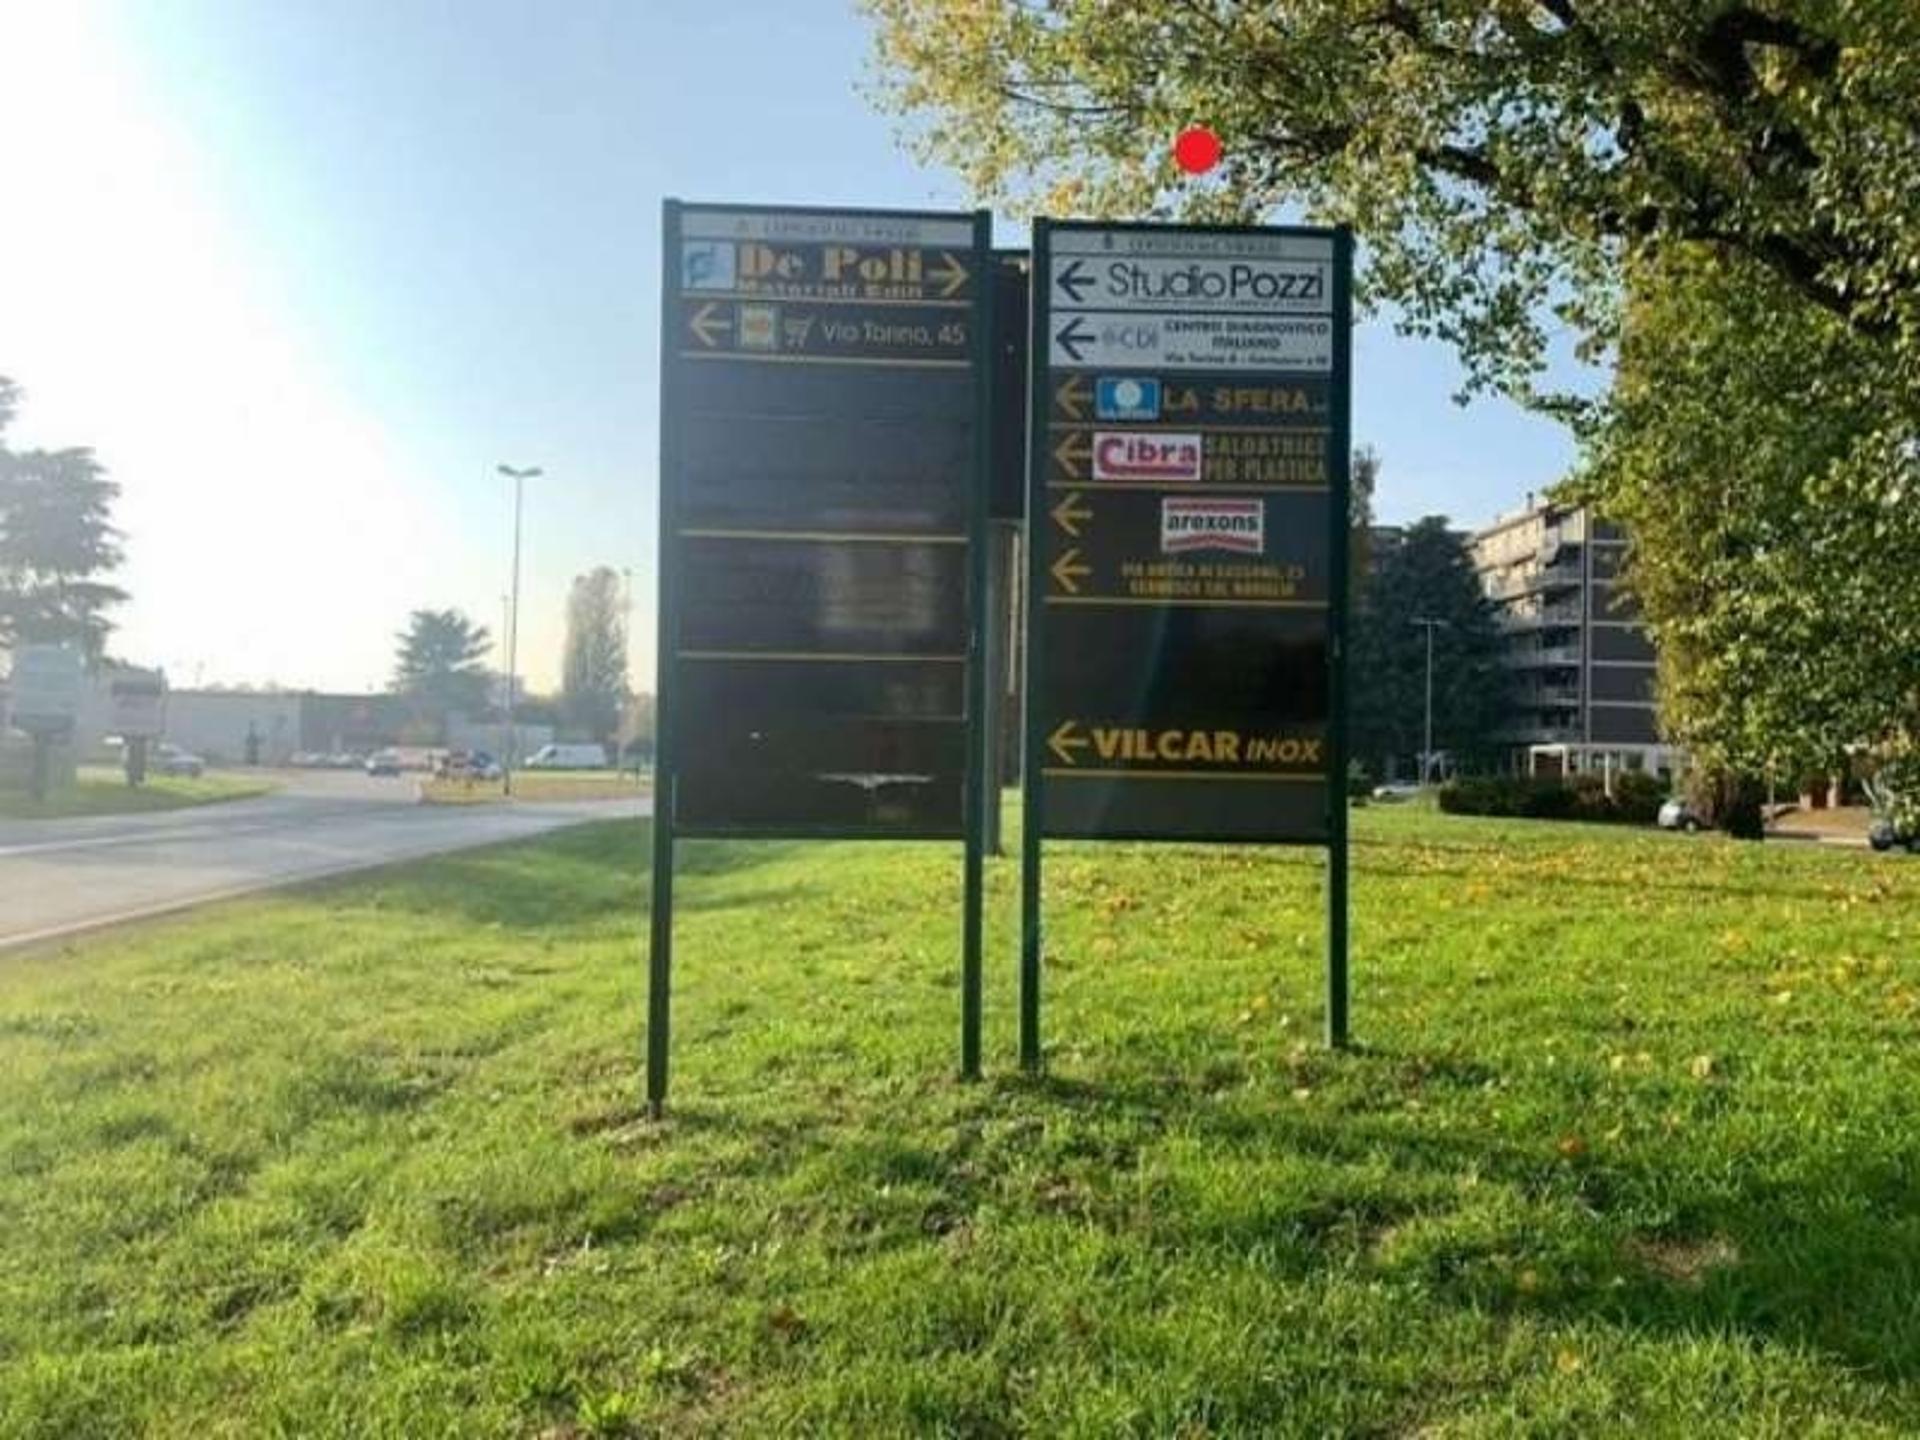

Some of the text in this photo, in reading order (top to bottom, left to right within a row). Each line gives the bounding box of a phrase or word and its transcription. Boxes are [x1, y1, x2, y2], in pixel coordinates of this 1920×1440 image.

[739, 246, 922, 281] De Poli
[822, 323, 859, 343] Via
[937, 325, 965, 345] 45
[1163, 387, 1200, 410] LA
[1213, 387, 1309, 412] SFERA
[1095, 436, 1199, 477] Cibra
[1166, 512, 1259, 533] arexons
[1093, 729, 1323, 763] VILCAR INOX
